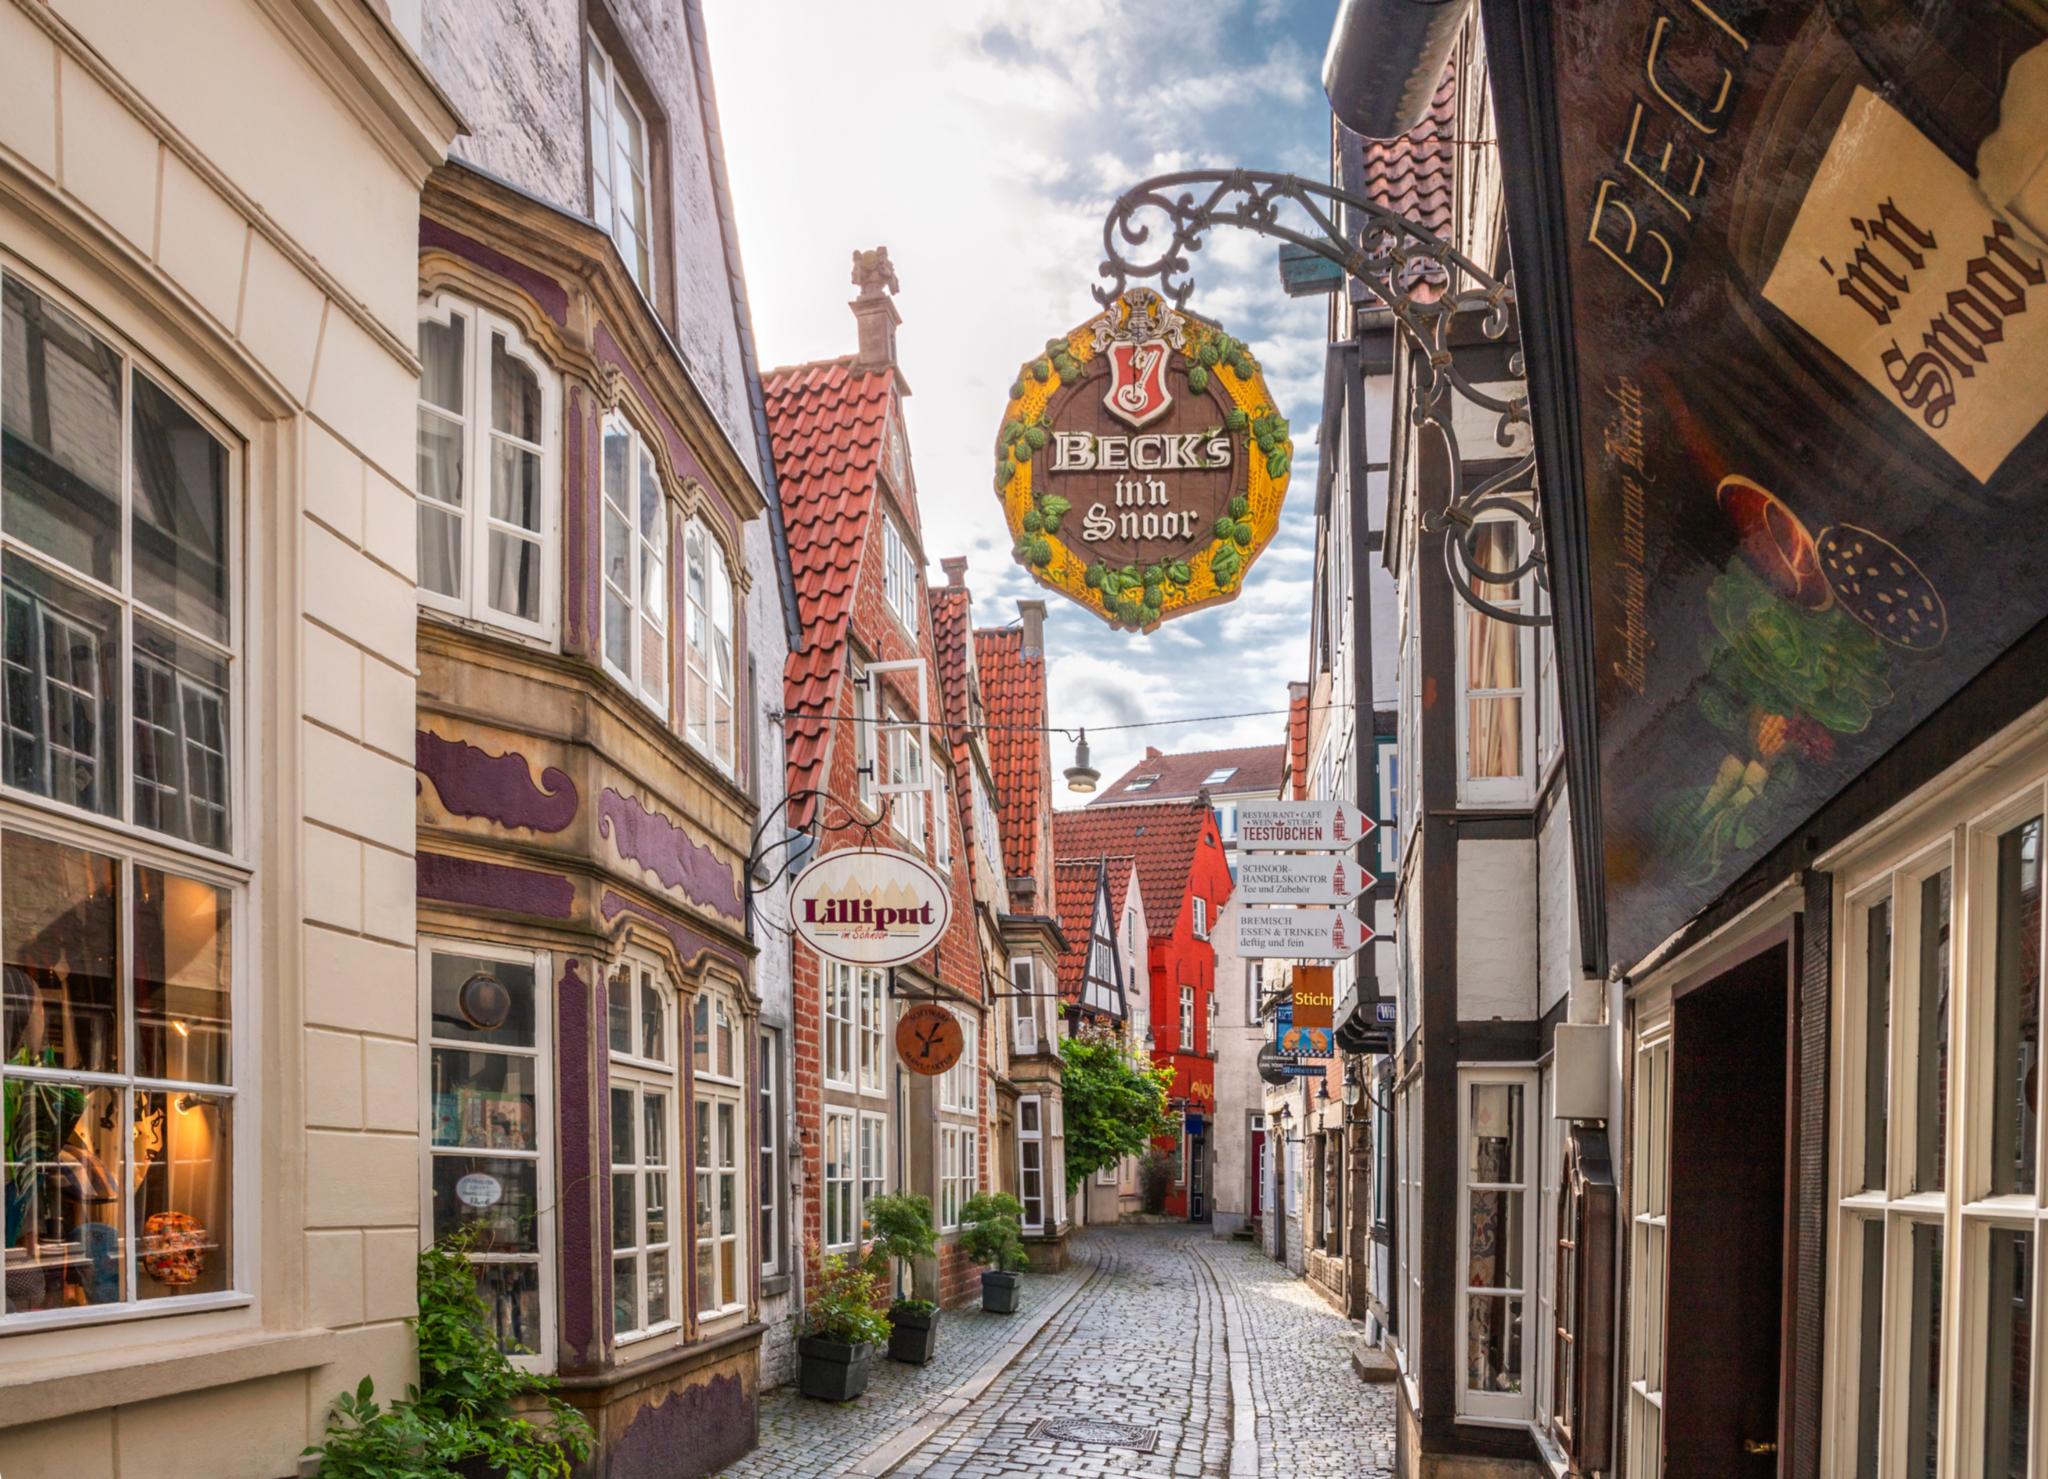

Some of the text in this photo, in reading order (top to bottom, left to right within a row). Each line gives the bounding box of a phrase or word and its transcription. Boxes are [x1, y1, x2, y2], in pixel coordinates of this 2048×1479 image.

[1881, 220, 2046, 429] Snoor
[1082, 503, 1199, 543] Snoor
[1243, 874, 1327, 883] HANDELSKONTOR
[1243, 885, 1310, 893] Tee und Zubehör
[803, 898, 935, 931] Lilliput
[1240, 916, 1292, 925] BREMISCH
[1241, 928, 1328, 936] ESSEN & TRINKEN
[1241, 938, 1304, 949] deftig und fein
